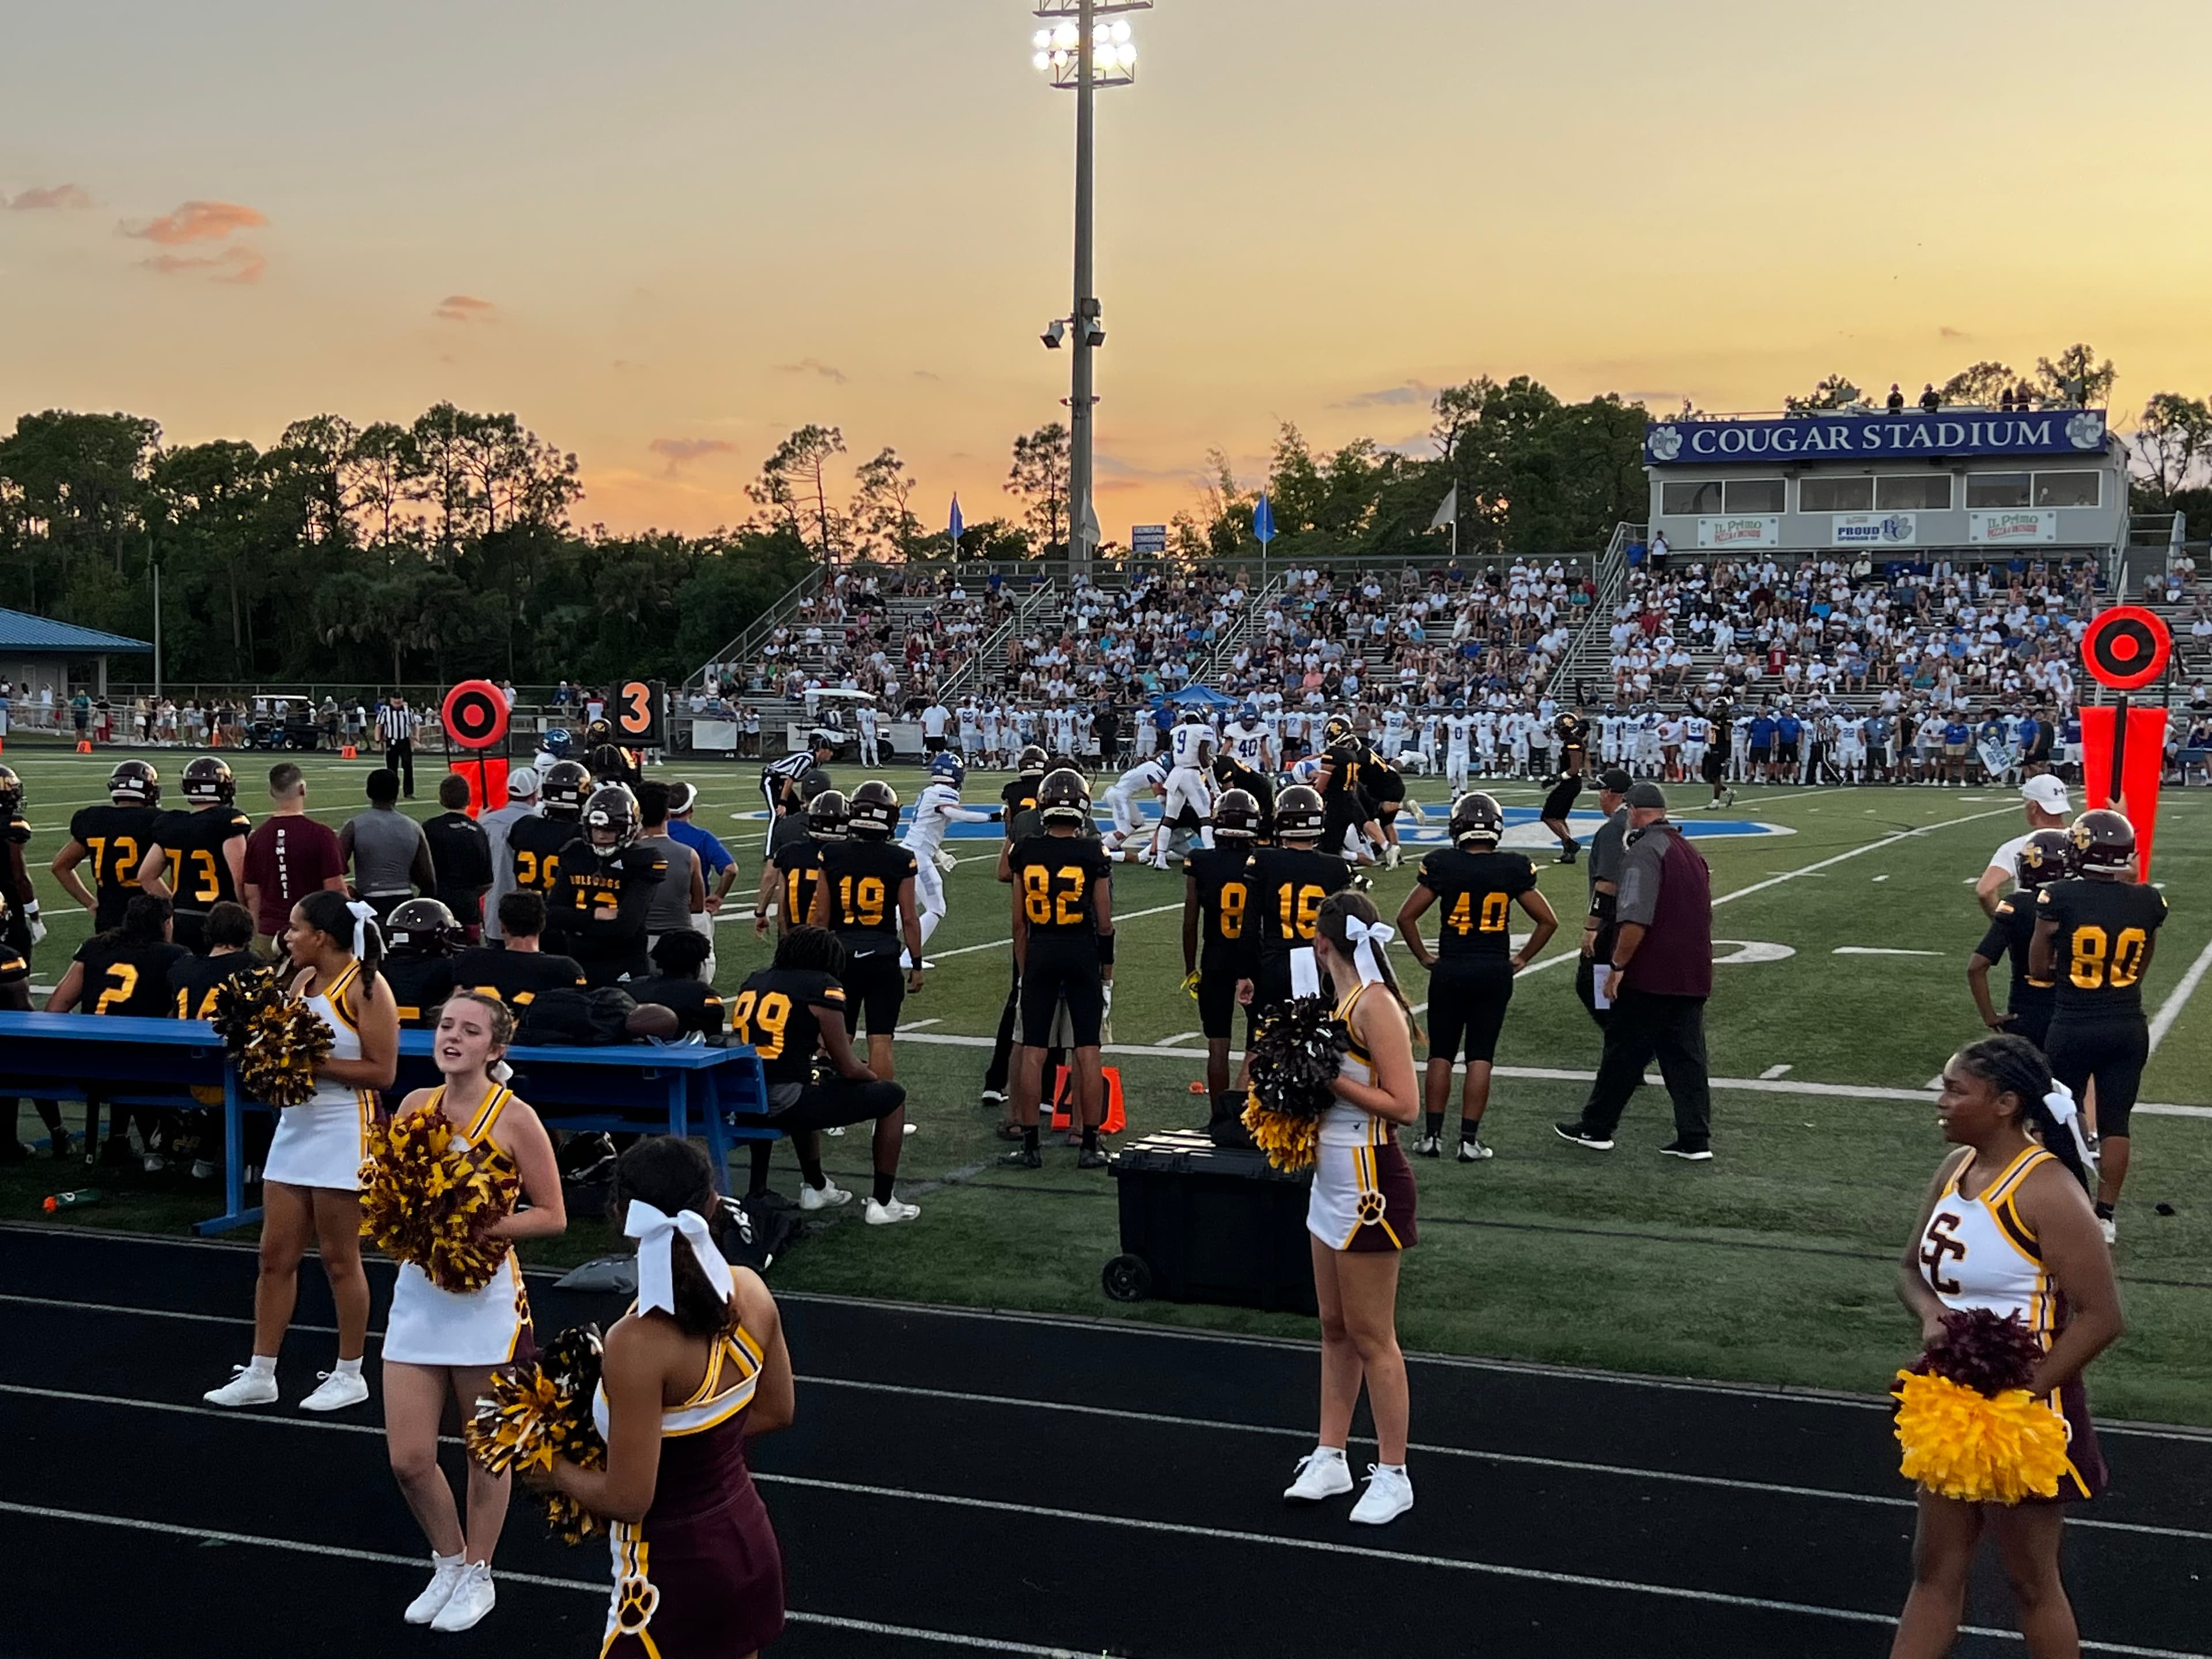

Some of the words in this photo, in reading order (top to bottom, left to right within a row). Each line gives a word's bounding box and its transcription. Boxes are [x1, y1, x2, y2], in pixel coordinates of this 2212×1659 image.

[1692, 426, 1853, 453] COUGAR
[1862, 420, 2052, 449] STADIUM
[1838, 527, 1880, 535] PROUD
[620, 682, 651, 733] 3
[1177, 730, 1187, 754] 9
[1238, 739, 1257, 757] 40
[1455, 726, 1463, 740] 0
[1843, 728, 1854, 738] 22
[86, 837, 142, 887] 72
[164, 848, 219, 902] 73
[839, 876, 885, 925] 19
[1024, 865, 1085, 925] 82
[1221, 882, 1247, 938] 8
[1278, 882, 1325, 938] 16
[1448, 892, 1509, 935] 40
[2070, 926, 2146, 988] 80
[94, 963, 138, 1015] 2
[733, 990, 792, 1059] 89
